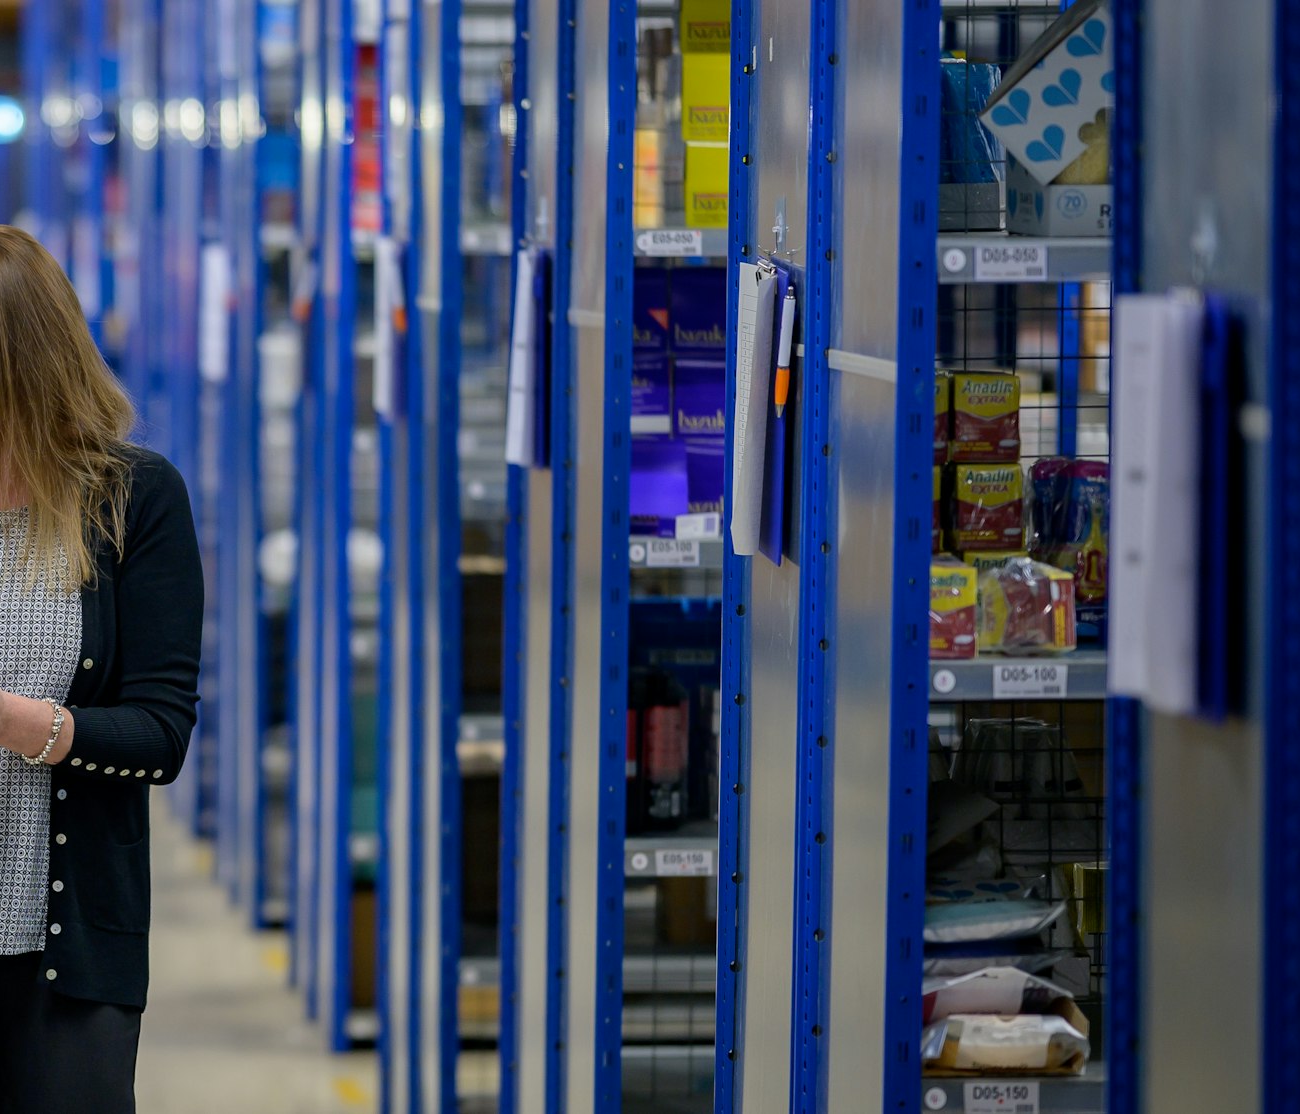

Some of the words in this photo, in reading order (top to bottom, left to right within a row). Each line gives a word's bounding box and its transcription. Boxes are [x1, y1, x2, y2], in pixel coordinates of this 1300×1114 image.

[982, 248, 1038, 262] D05-050
[963, 380, 1013, 394] Anadin
[965, 470, 1013, 483] Anadin
[1002, 668, 1056, 681] D05-100
[663, 853, 703, 864] E05-150
[972, 1085, 1029, 1100] D05-150
